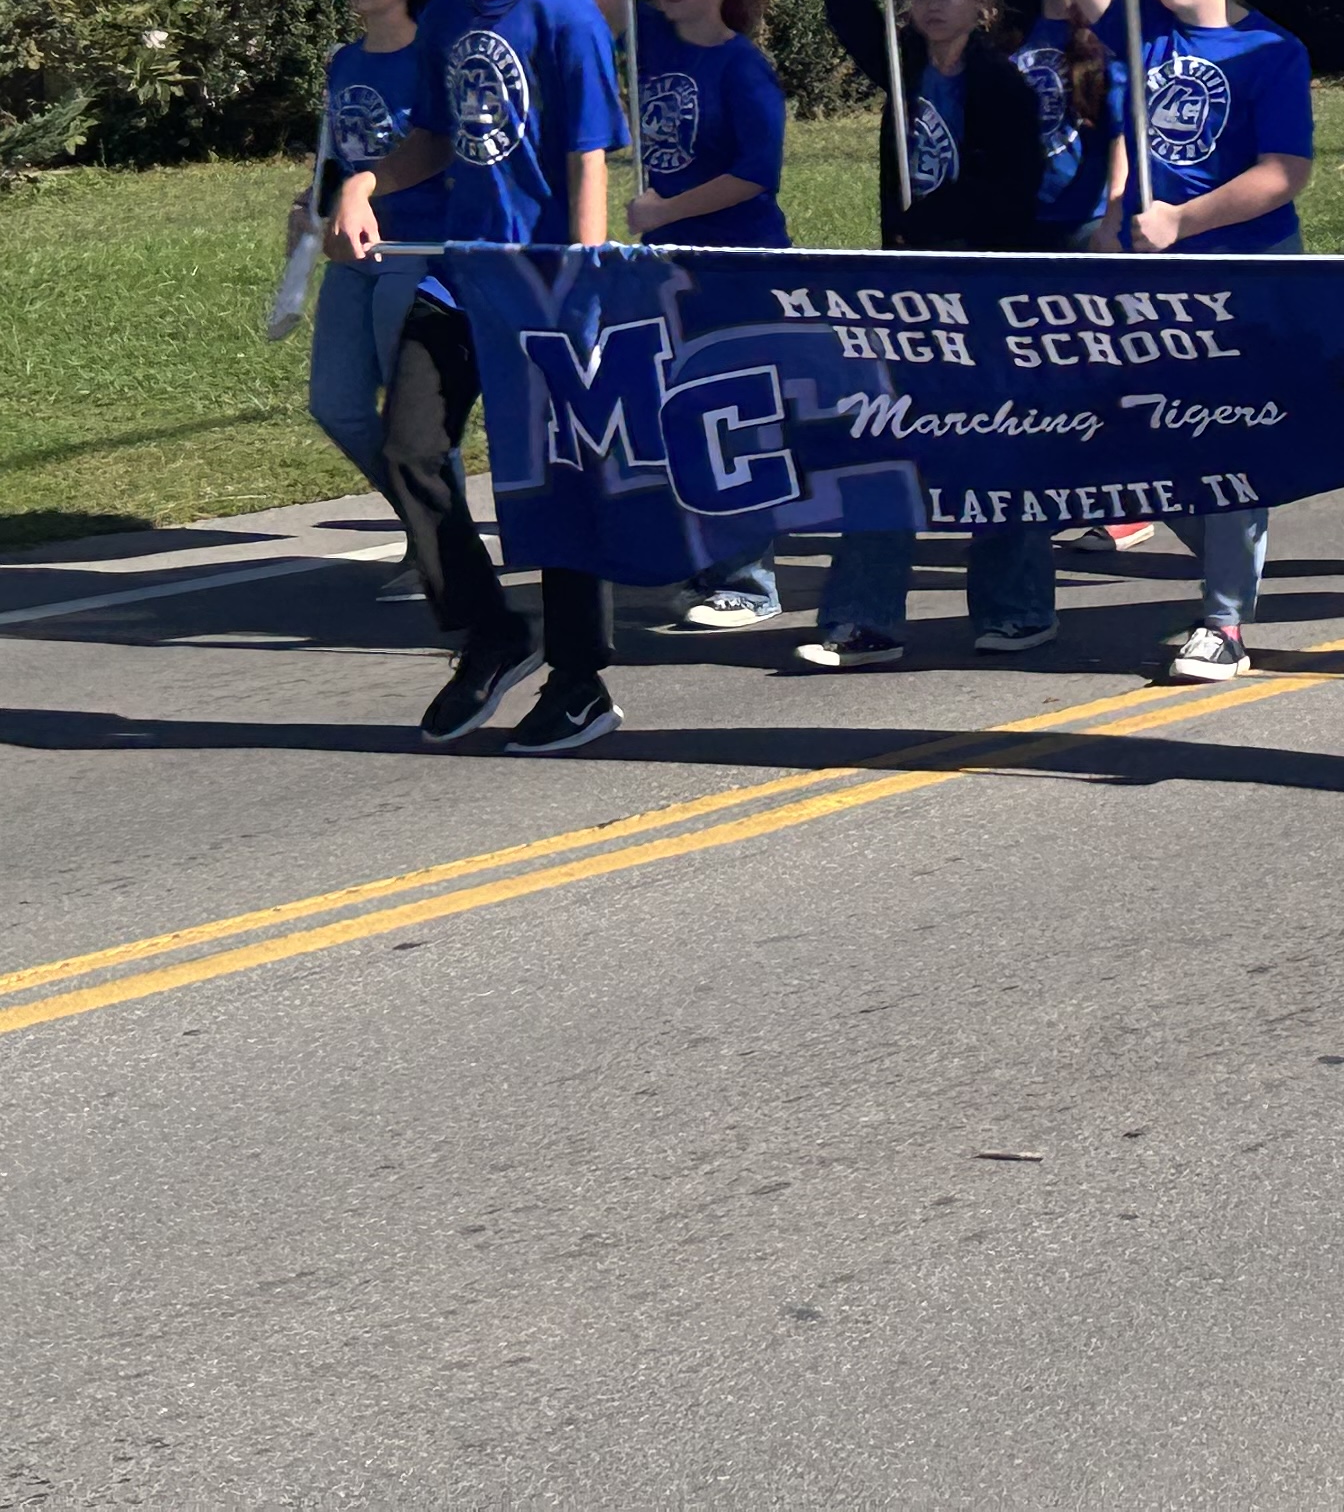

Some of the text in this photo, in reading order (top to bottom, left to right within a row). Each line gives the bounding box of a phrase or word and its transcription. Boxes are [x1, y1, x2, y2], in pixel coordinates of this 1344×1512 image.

[771, 287, 1234, 329] MACON COUNTY
[832, 324, 1241, 369] HIGH SCHOOL
[519, 316, 801, 517] MC
[836, 393, 1289, 442] Marching Tigers
[928, 472, 1260, 524] LAFAYETTE, TN
